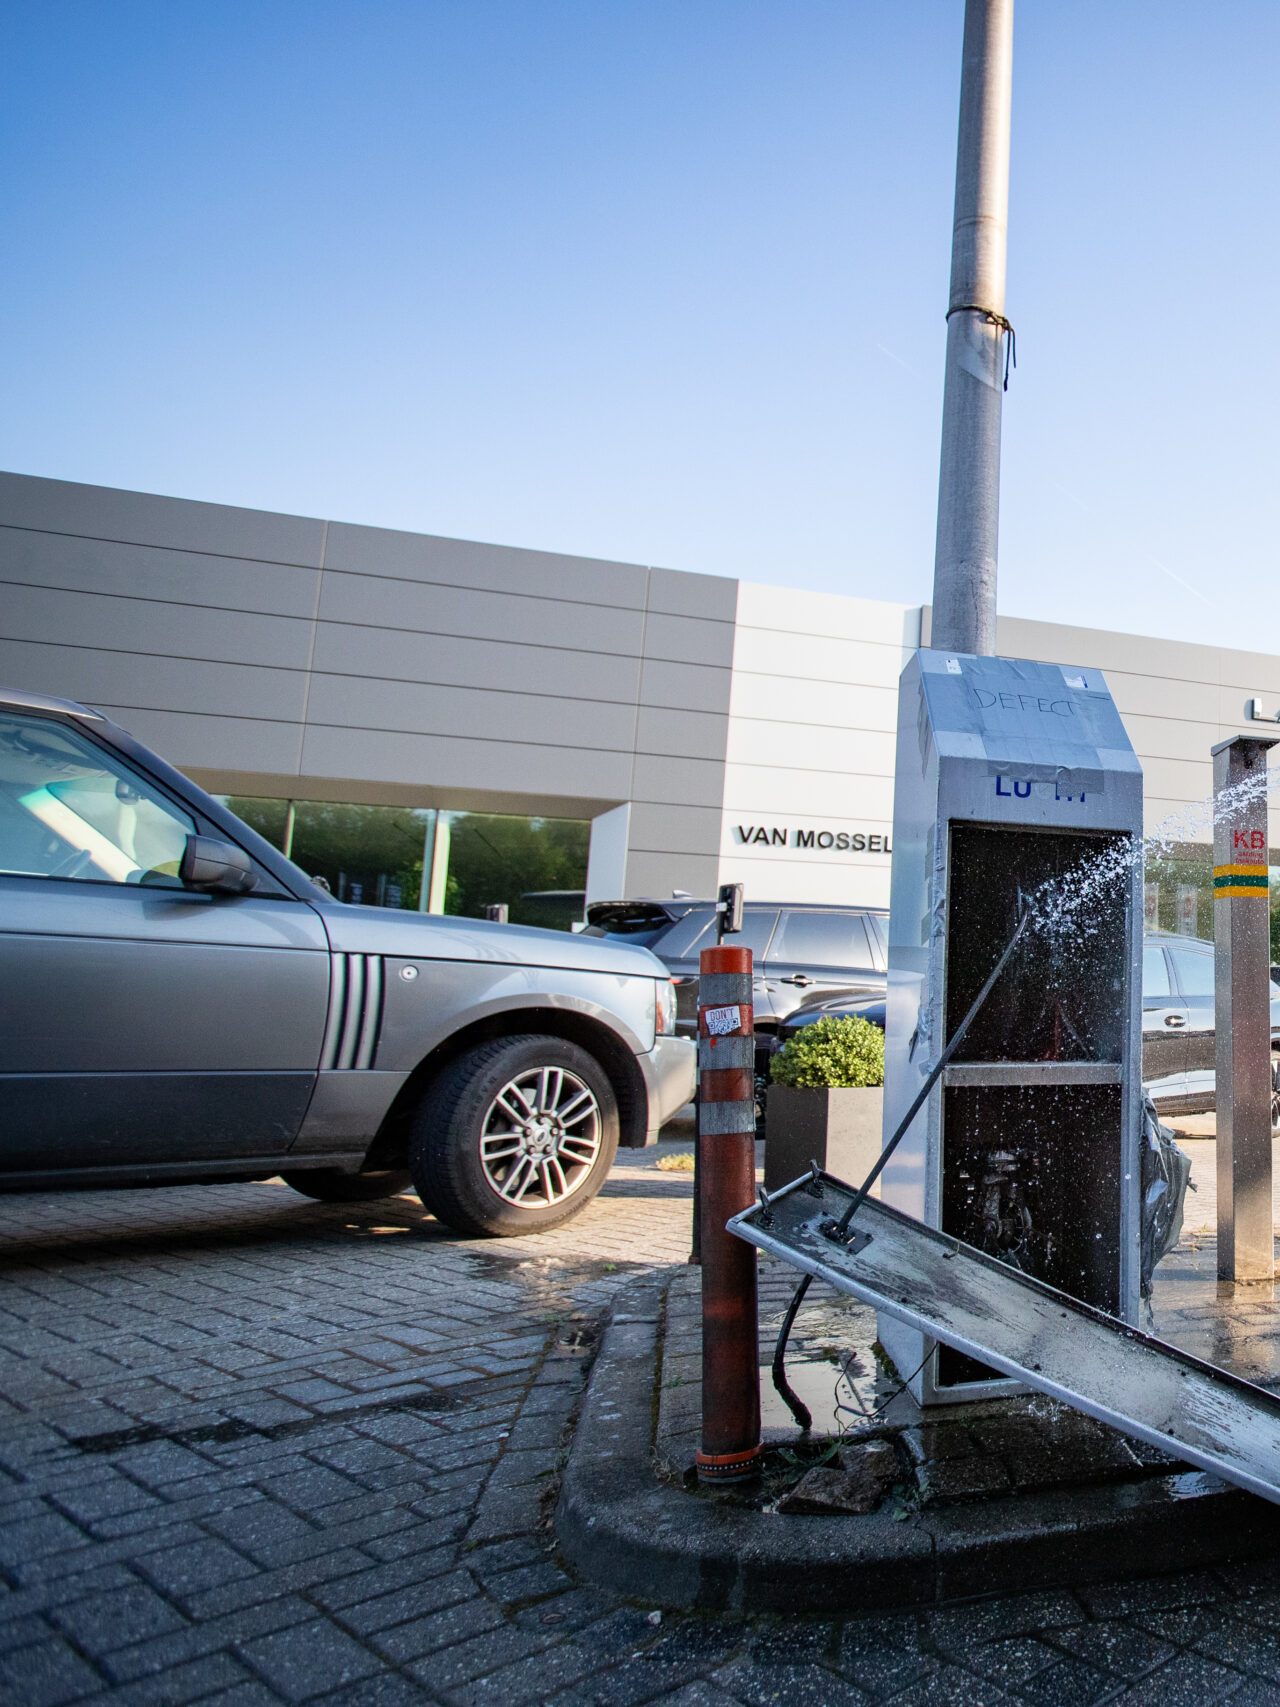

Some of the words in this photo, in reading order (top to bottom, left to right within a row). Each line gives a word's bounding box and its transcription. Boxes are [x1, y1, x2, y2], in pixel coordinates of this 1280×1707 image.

[974, 688, 1080, 717] DEFECT
[738, 825, 787, 846] VAN
[796, 829, 893, 853] MOSSEL
[1234, 829, 1265, 849] KB
